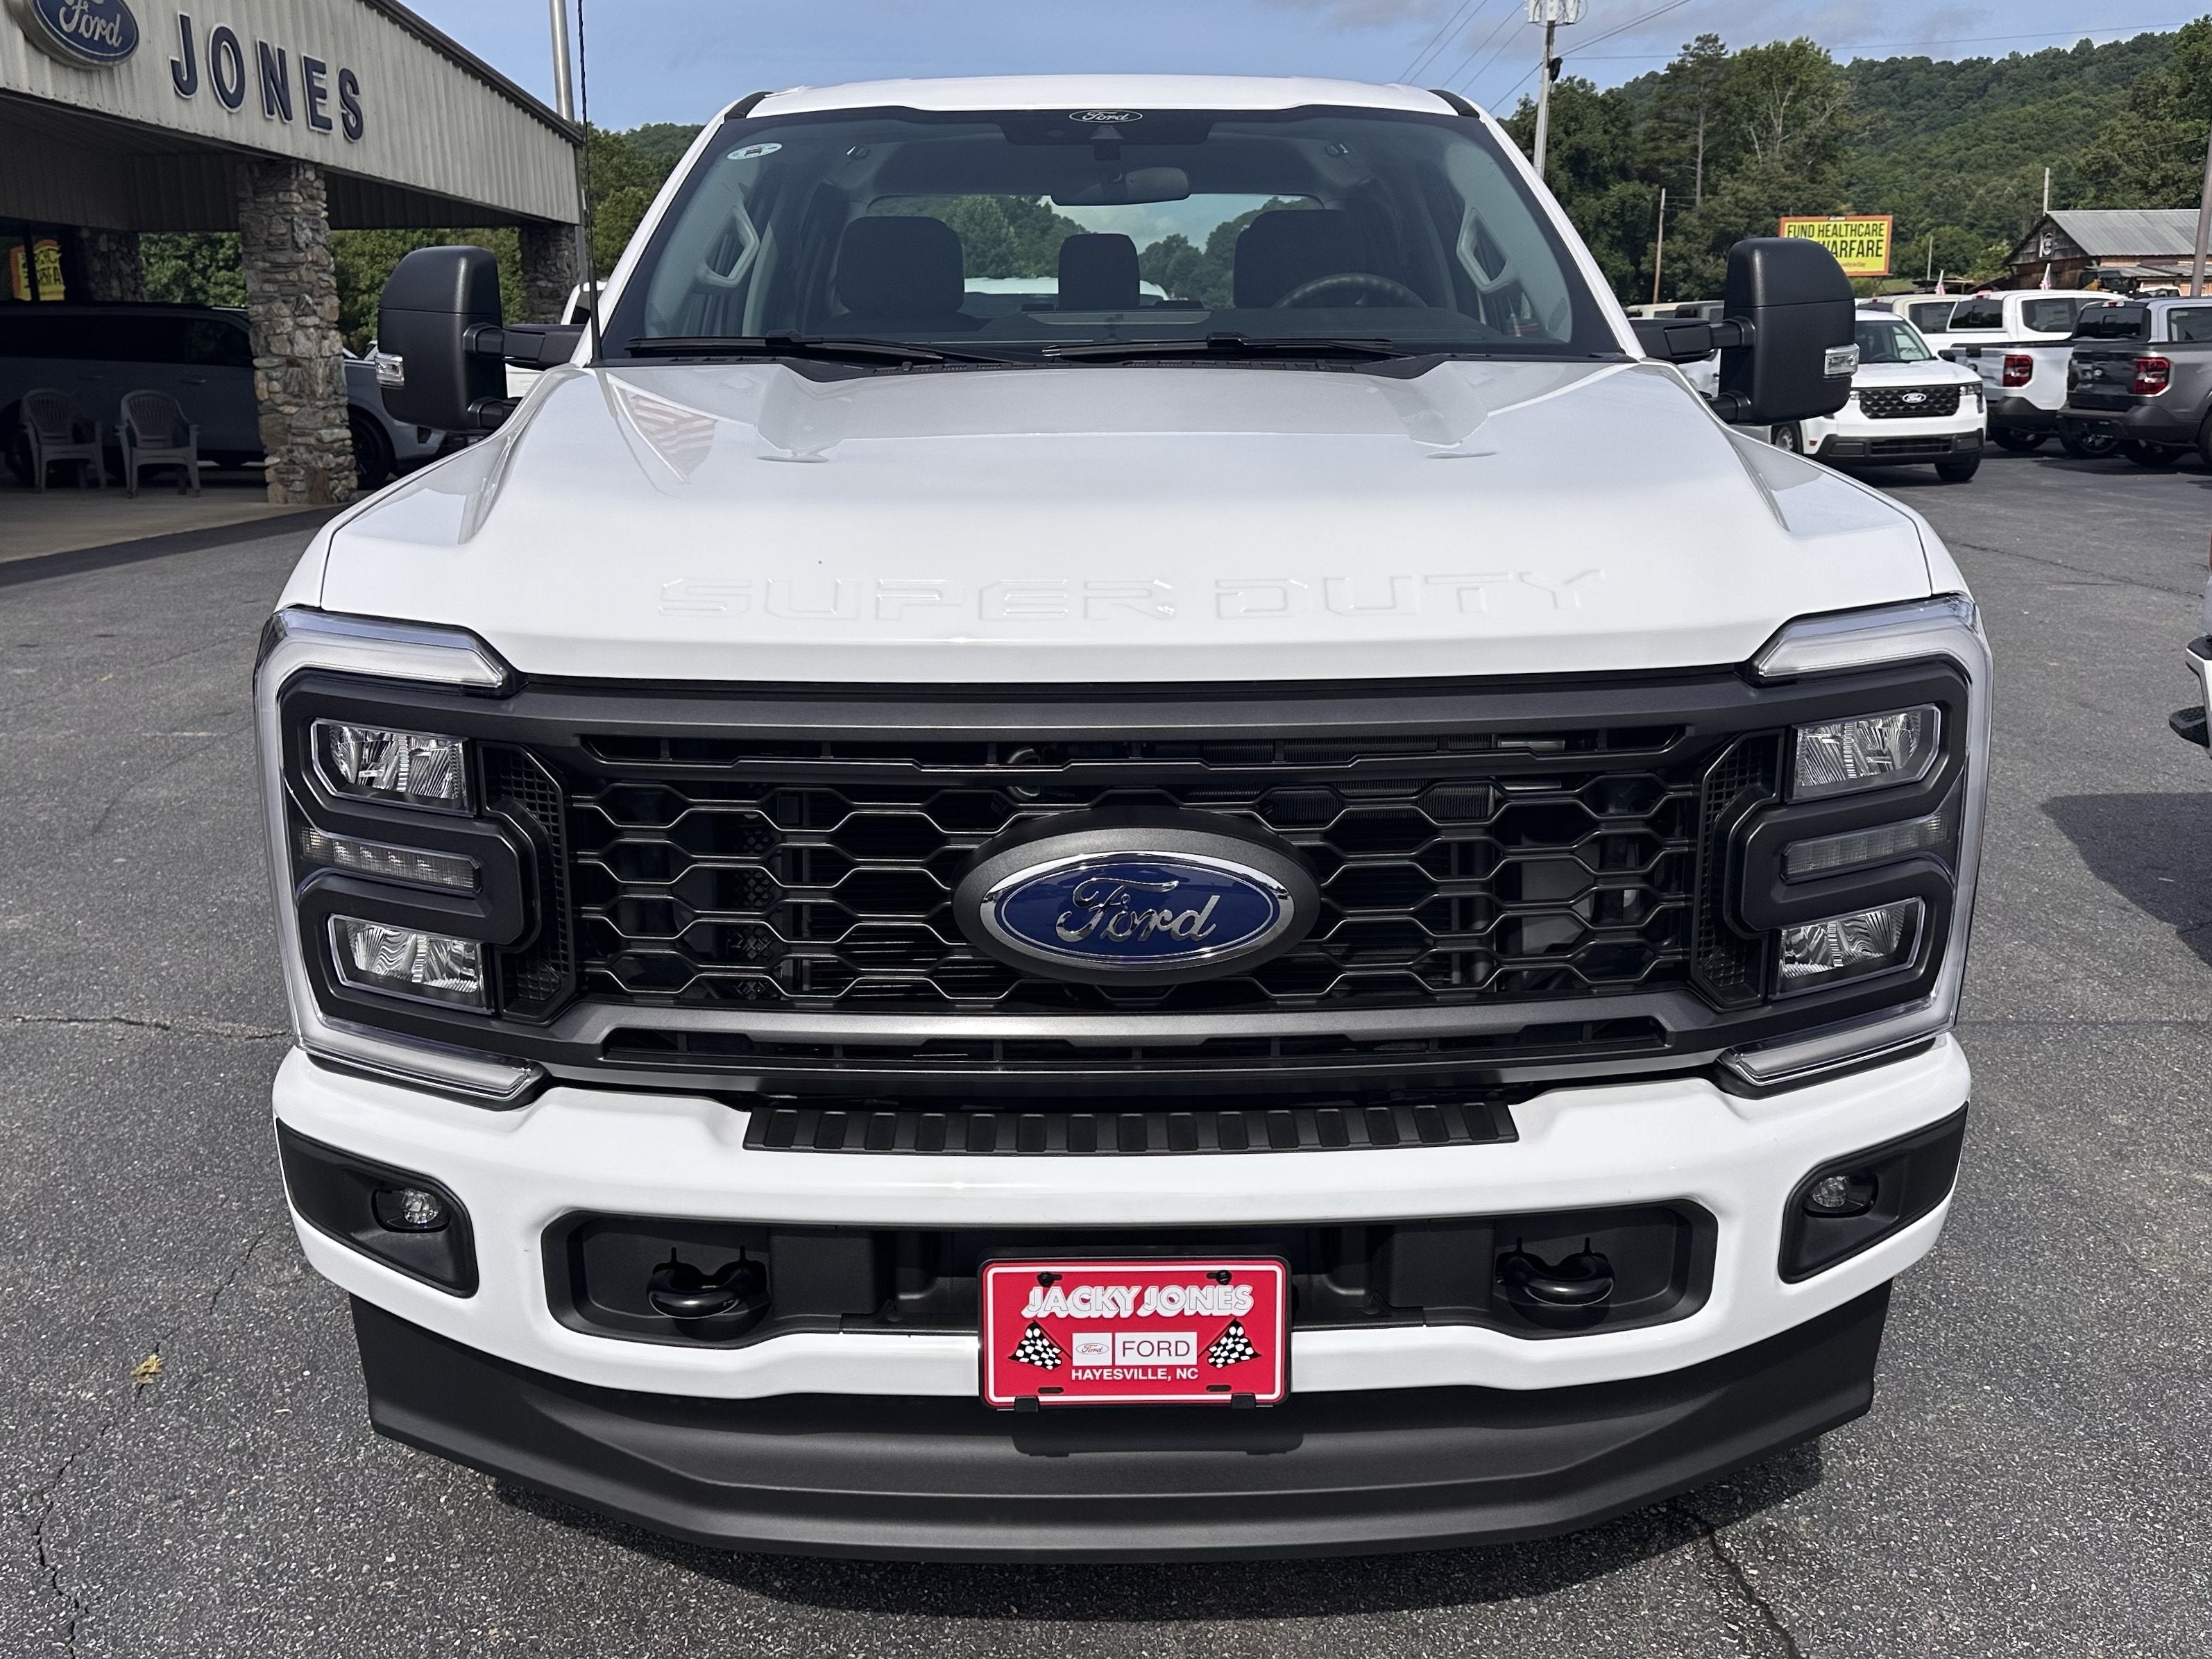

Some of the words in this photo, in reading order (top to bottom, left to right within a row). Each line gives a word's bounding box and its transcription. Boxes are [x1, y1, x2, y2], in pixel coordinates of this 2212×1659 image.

[59, 0, 122, 46] Ford
[169, 10, 364, 143] JONES
[1082, 111, 1130, 121] Ford
[1787, 224, 1815, 238] FUND
[1817, 223, 1885, 237] HEALTHCARE
[658, 577, 1178, 621] SUPER
[1214, 570, 1605, 619] DUTY
[1055, 877, 1221, 942] Ford
[1021, 1284, 1143, 1318] JACKY
[1136, 1284, 1254, 1318] JONES
[1081, 1343, 1103, 1353] Ford
[1122, 1340, 1191, 1357] FORD
[1071, 1368, 1172, 1381] HAYESVILLE,
[1176, 1368, 1199, 1380] NC
